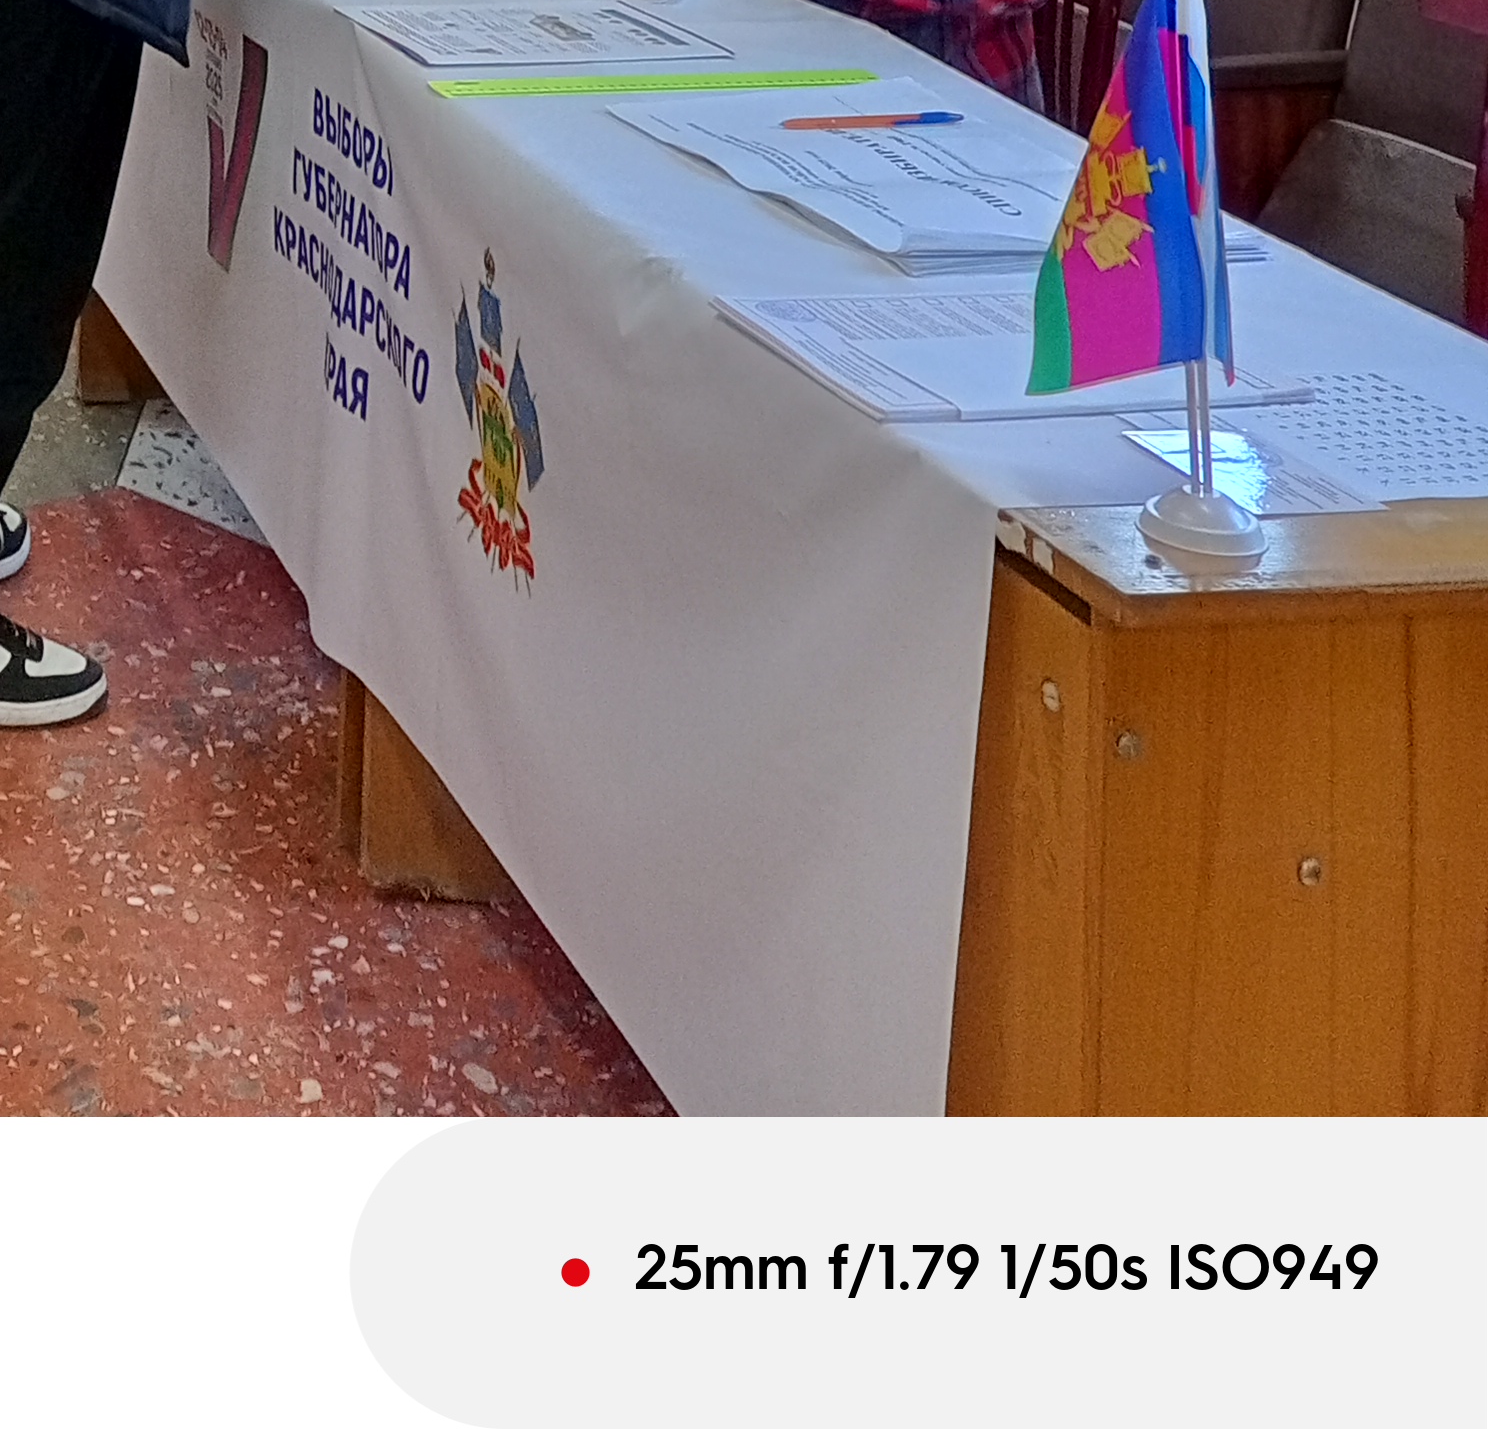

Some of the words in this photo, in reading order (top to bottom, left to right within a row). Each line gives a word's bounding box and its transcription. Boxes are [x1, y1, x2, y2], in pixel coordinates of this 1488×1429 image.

[313, 87, 393, 196] ВЫБОРЫ
[292, 147, 410, 301] ГУБЕРНАТОРА
[273, 205, 429, 405] КРАСНОДАРСКОГО
[324, 331, 370, 422] РАЯ
